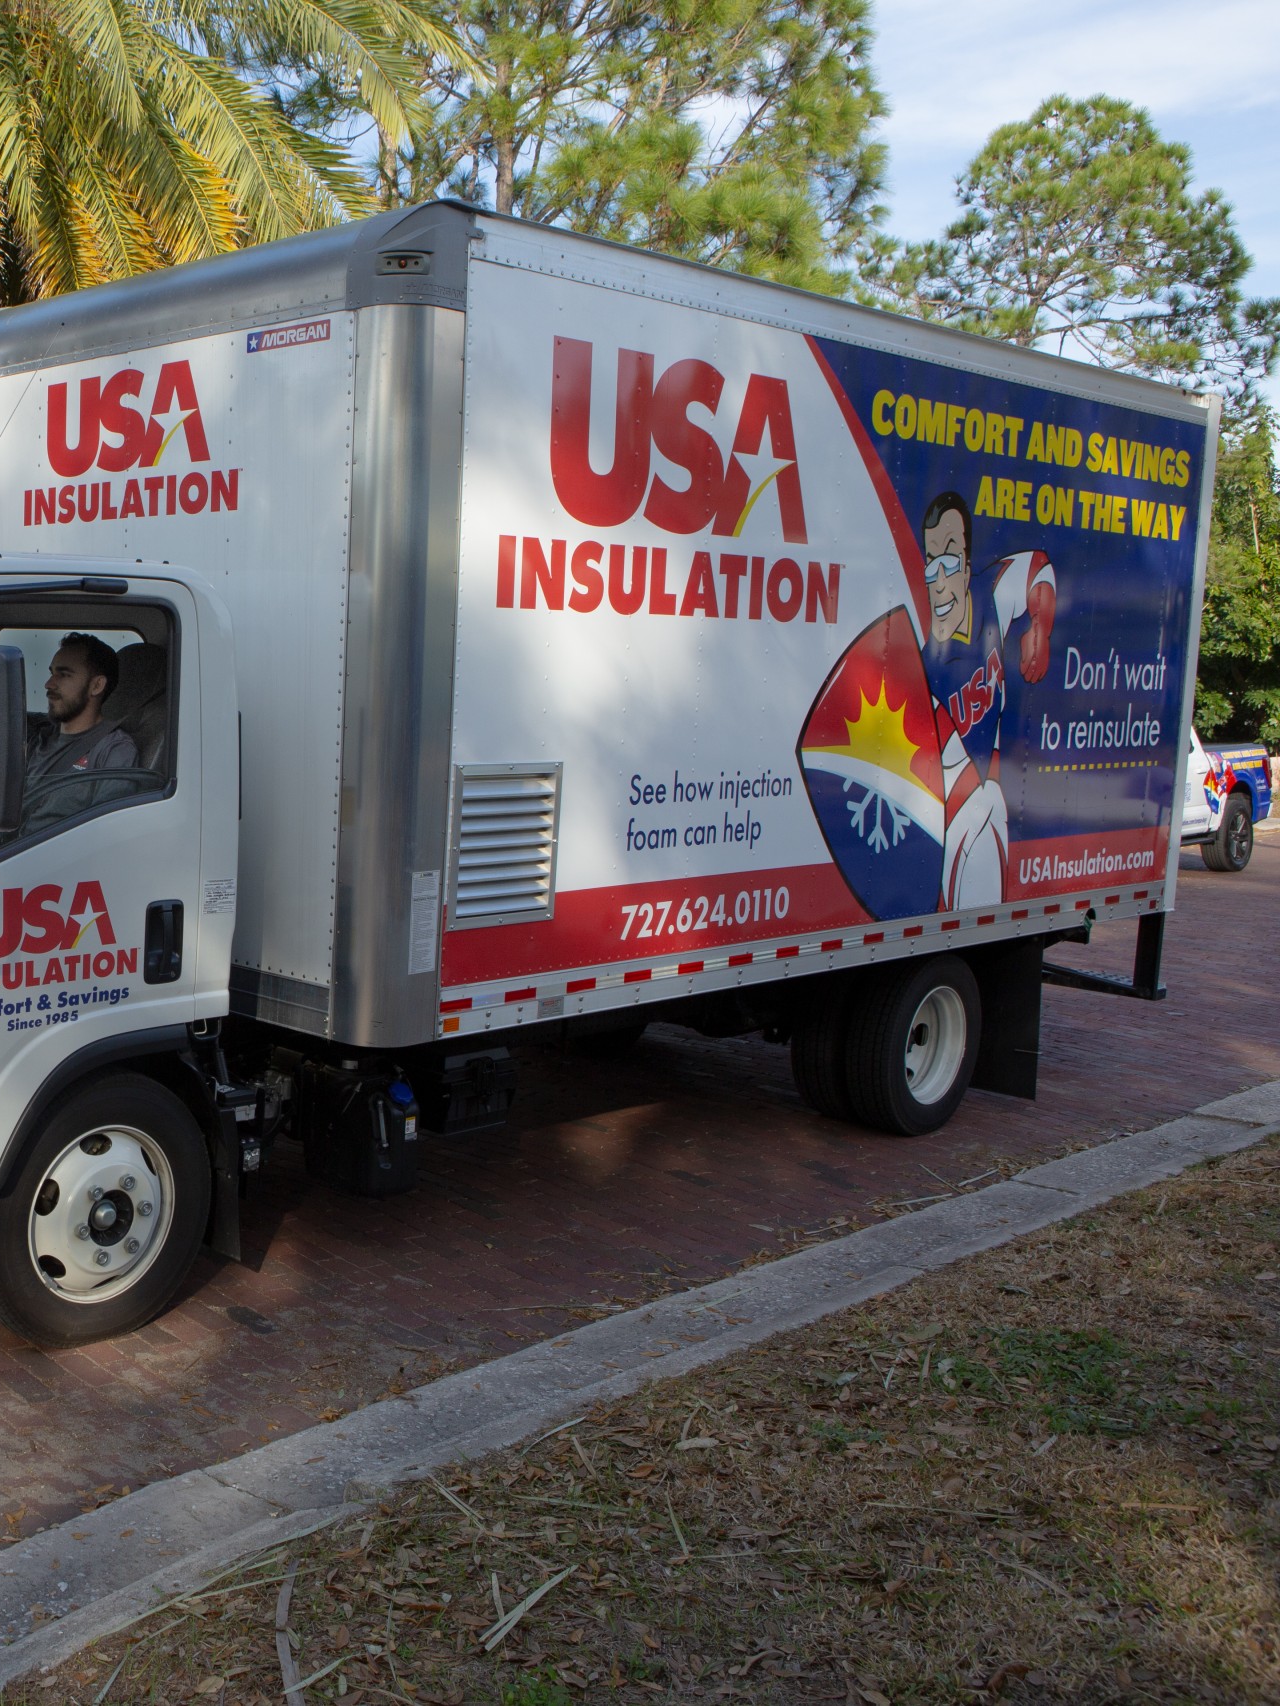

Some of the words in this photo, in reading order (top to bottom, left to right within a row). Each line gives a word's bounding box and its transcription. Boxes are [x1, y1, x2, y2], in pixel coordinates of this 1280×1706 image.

[261, 323, 328, 349] MORGAN
[47, 359, 211, 478] USA
[550, 335, 808, 545] USA
[871, 389, 1024, 458] COMFORT
[1026, 421, 1083, 468] AND
[1086, 432, 1191, 488] SAVINGS
[24, 468, 239, 526] INSULATION
[974, 475, 1032, 522] ARE
[1036, 484, 1074, 527] ON
[1079, 490, 1128, 534] THE
[1131, 499, 1187, 541] WAY
[496, 534, 841, 625] INSULATION
[948, 648, 1004, 738] USA
[1064, 647, 1120, 691] Don't
[1124, 653, 1167, 691] wait
[1040, 713, 1061, 750] to
[1067, 703, 1161, 750] reinsulate
[629, 774, 667, 806] See
[673, 770, 714, 803] how
[719, 769, 793, 808] injection
[626, 817, 677, 852] foam
[684, 824, 717, 847] can
[723, 810, 762, 850] help
[1020, 847, 1155, 885] USAInsulation.com
[620, 886, 790, 941] 727.624.0110
[7, 1015, 43, 1032] Since
[45, 1010, 79, 1027] 1985
[37, 993, 52, 1010] &
[57, 985, 130, 1009] Savings
